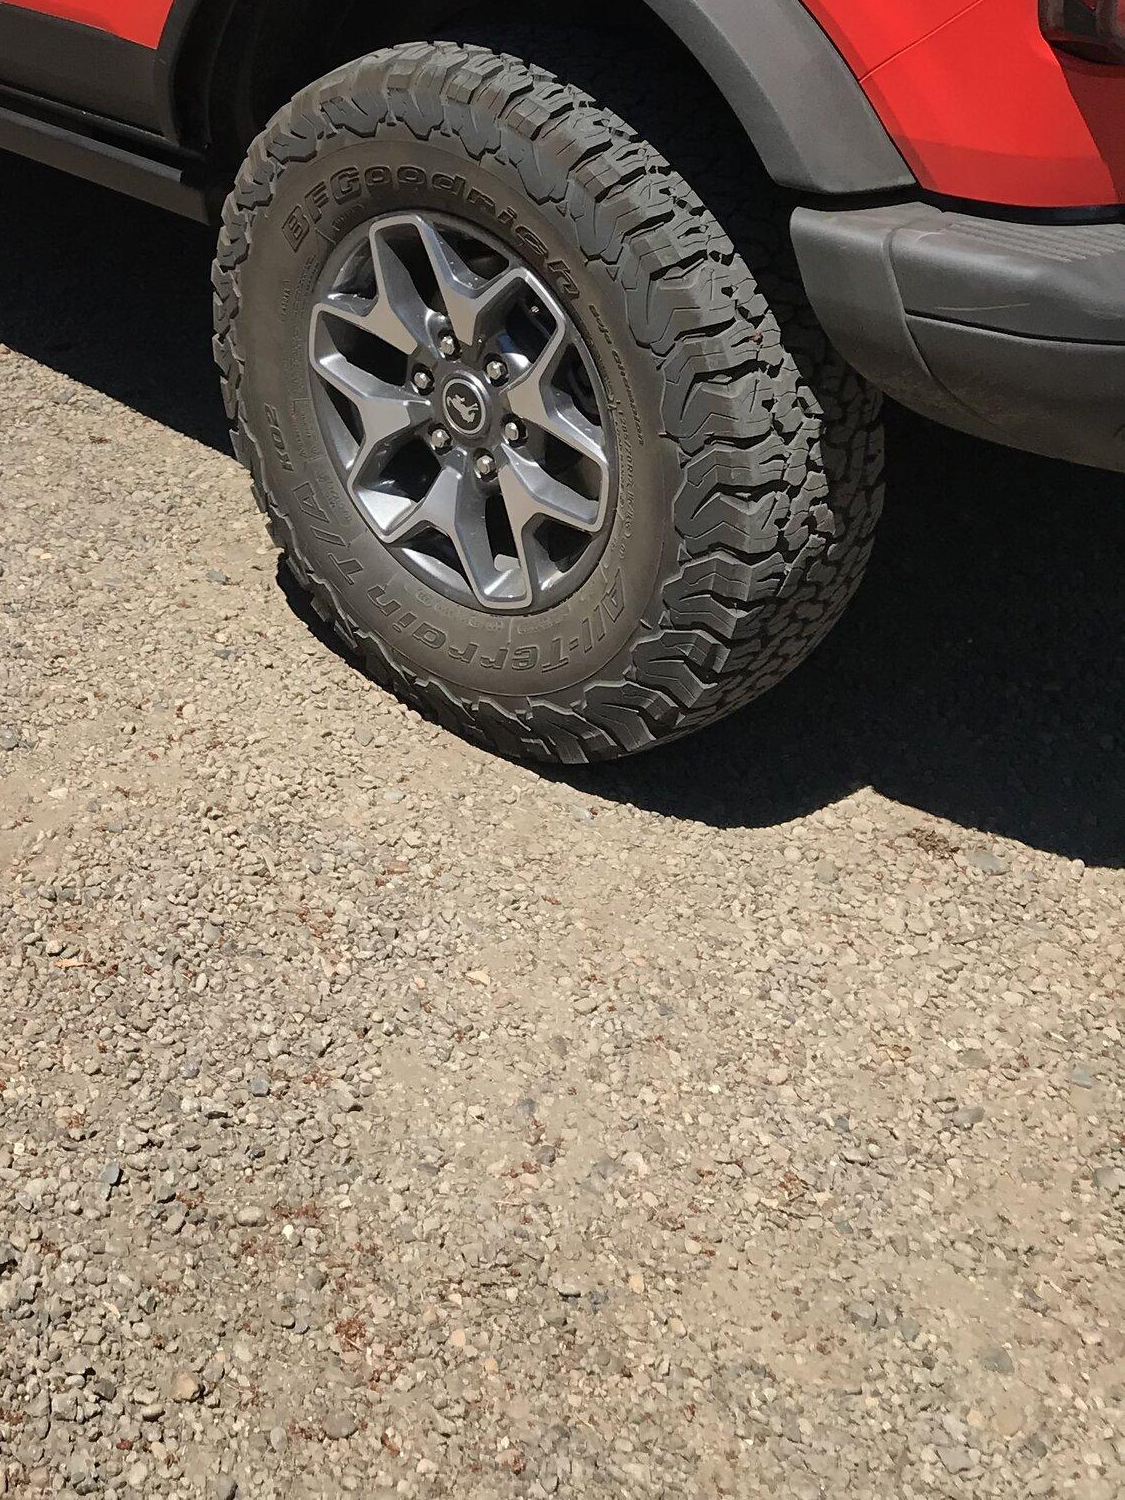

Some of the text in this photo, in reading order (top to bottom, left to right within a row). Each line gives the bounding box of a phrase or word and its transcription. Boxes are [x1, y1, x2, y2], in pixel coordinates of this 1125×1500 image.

[281, 165, 579, 297] BFGoodrich
[292, 482, 364, 586] T/A
[366, 567, 625, 673] All-Terrain
